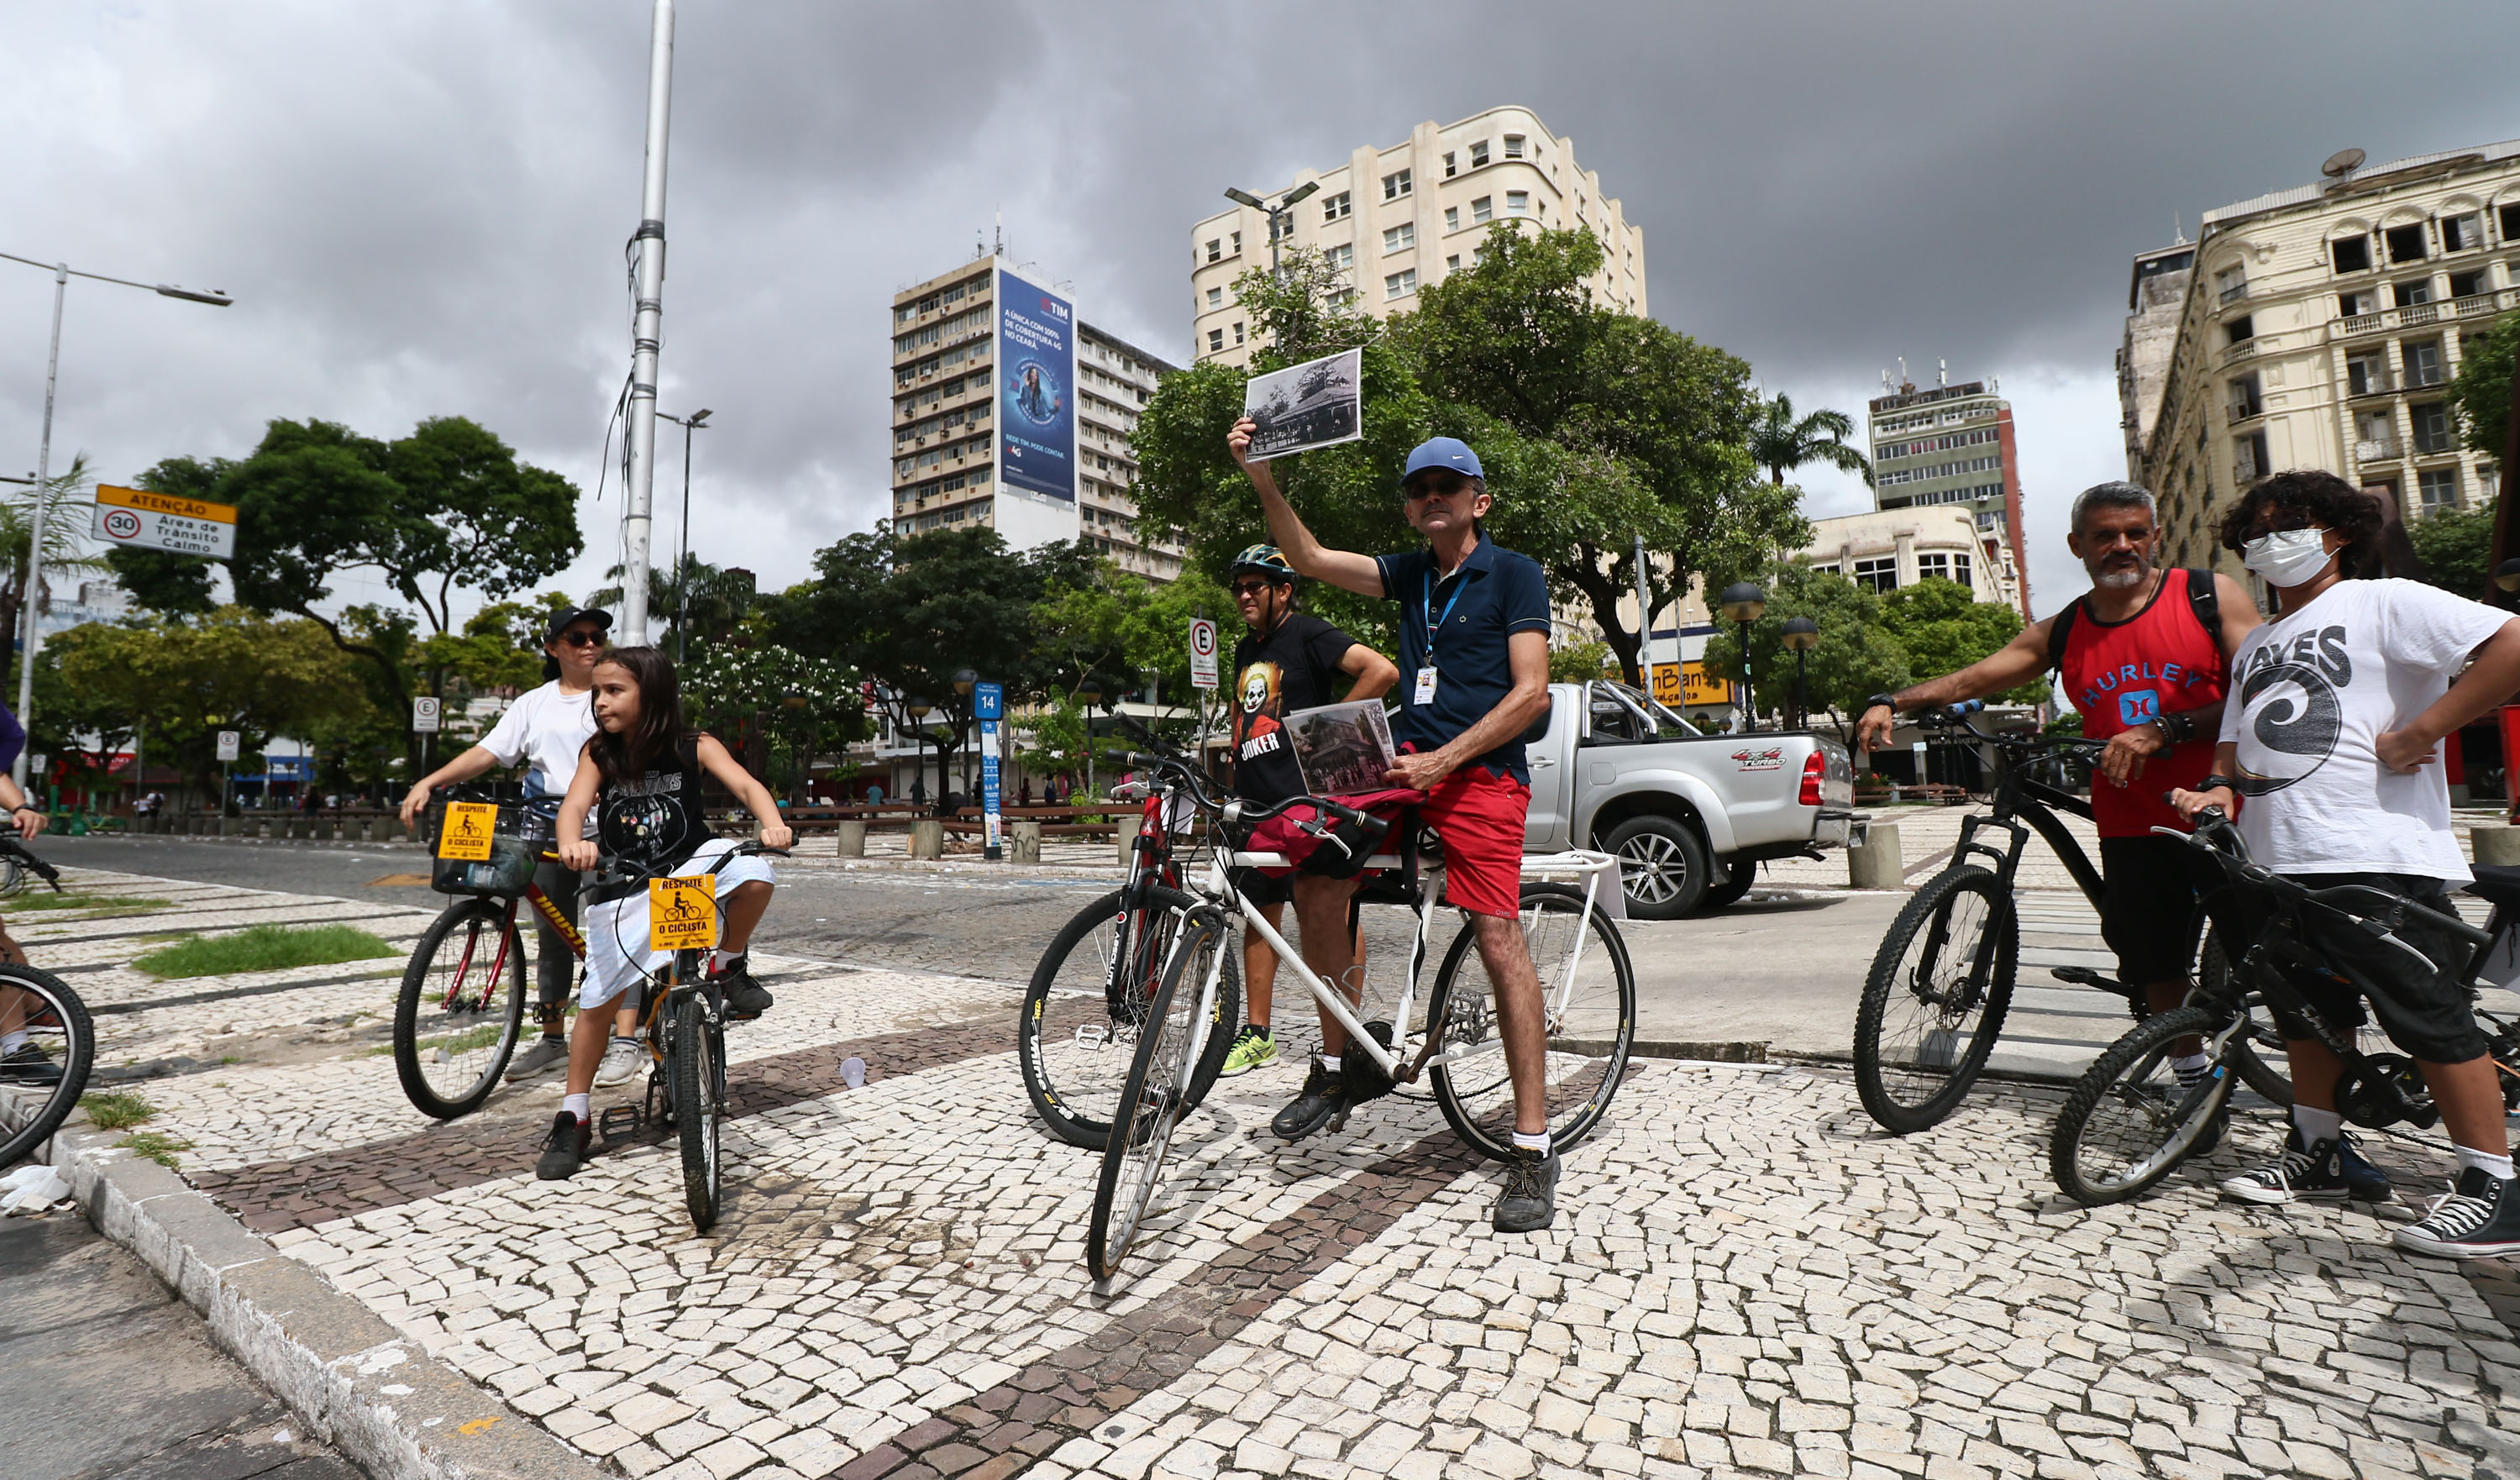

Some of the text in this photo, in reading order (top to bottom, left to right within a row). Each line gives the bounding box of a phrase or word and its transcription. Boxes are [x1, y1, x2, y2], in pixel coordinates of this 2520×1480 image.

[1051, 302, 1068, 320] TIM
[1005, 308, 1011, 318] A
[1011, 309, 1030, 326] ÚNICA
[1030, 321, 1043, 333] COM
[1005, 318, 1014, 329] DE
[1015, 323, 1053, 347] COBERTURA
[1005, 328, 1016, 339] NO
[1005, 433, 1020, 444] REDE
[1031, 442, 1044, 454] PODE
[1011, 445, 1021, 458] 4G
[130, 494, 207, 515] ATENÇÃO
[110, 516, 135, 531] 30
[200, 522, 219, 533] de
[156, 525, 219, 543] Trânsito
[162, 538, 211, 553] Calmo
[1199, 628, 1208, 648] E
[2081, 662, 2201, 707] HURLEY
[423, 702, 430, 712] E
[981, 695, 995, 709] 14
[1242, 732, 1280, 761] JOKER
[1743, 758, 1787, 766] TURBO
[457, 805, 487, 813] RESPEITE
[447, 838, 484, 847] O CICLISTA
[662, 878, 702, 890] RESPEITE
[659, 921, 707, 934] O CICLISTA
[1106, 931, 1121, 987] ABSOLUTE
